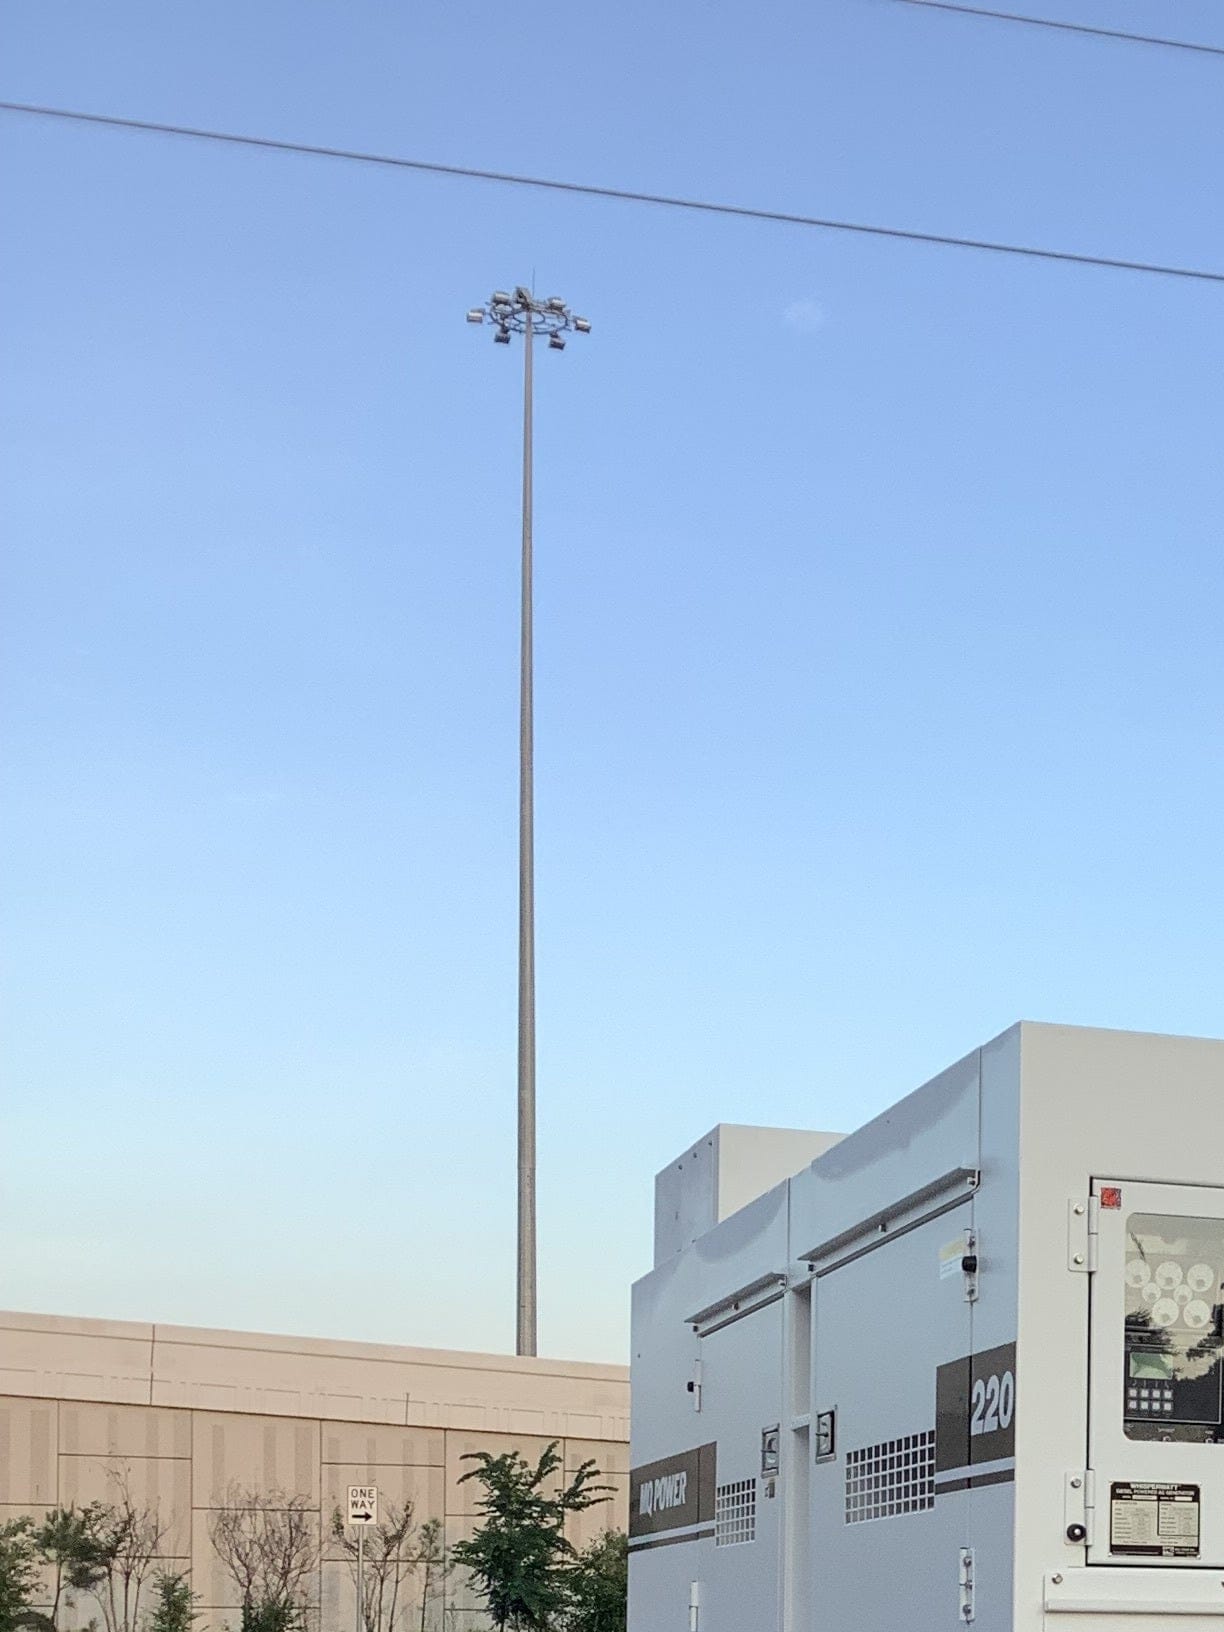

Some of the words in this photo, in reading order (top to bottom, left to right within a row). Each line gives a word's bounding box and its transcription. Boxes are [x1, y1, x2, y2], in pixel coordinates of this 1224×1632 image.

[970, 1370, 1014, 1436] 220
[351, 1488, 374, 1498] ONE
[653, 1471, 687, 1511] POWER
[351, 1500, 375, 1509] WAY
